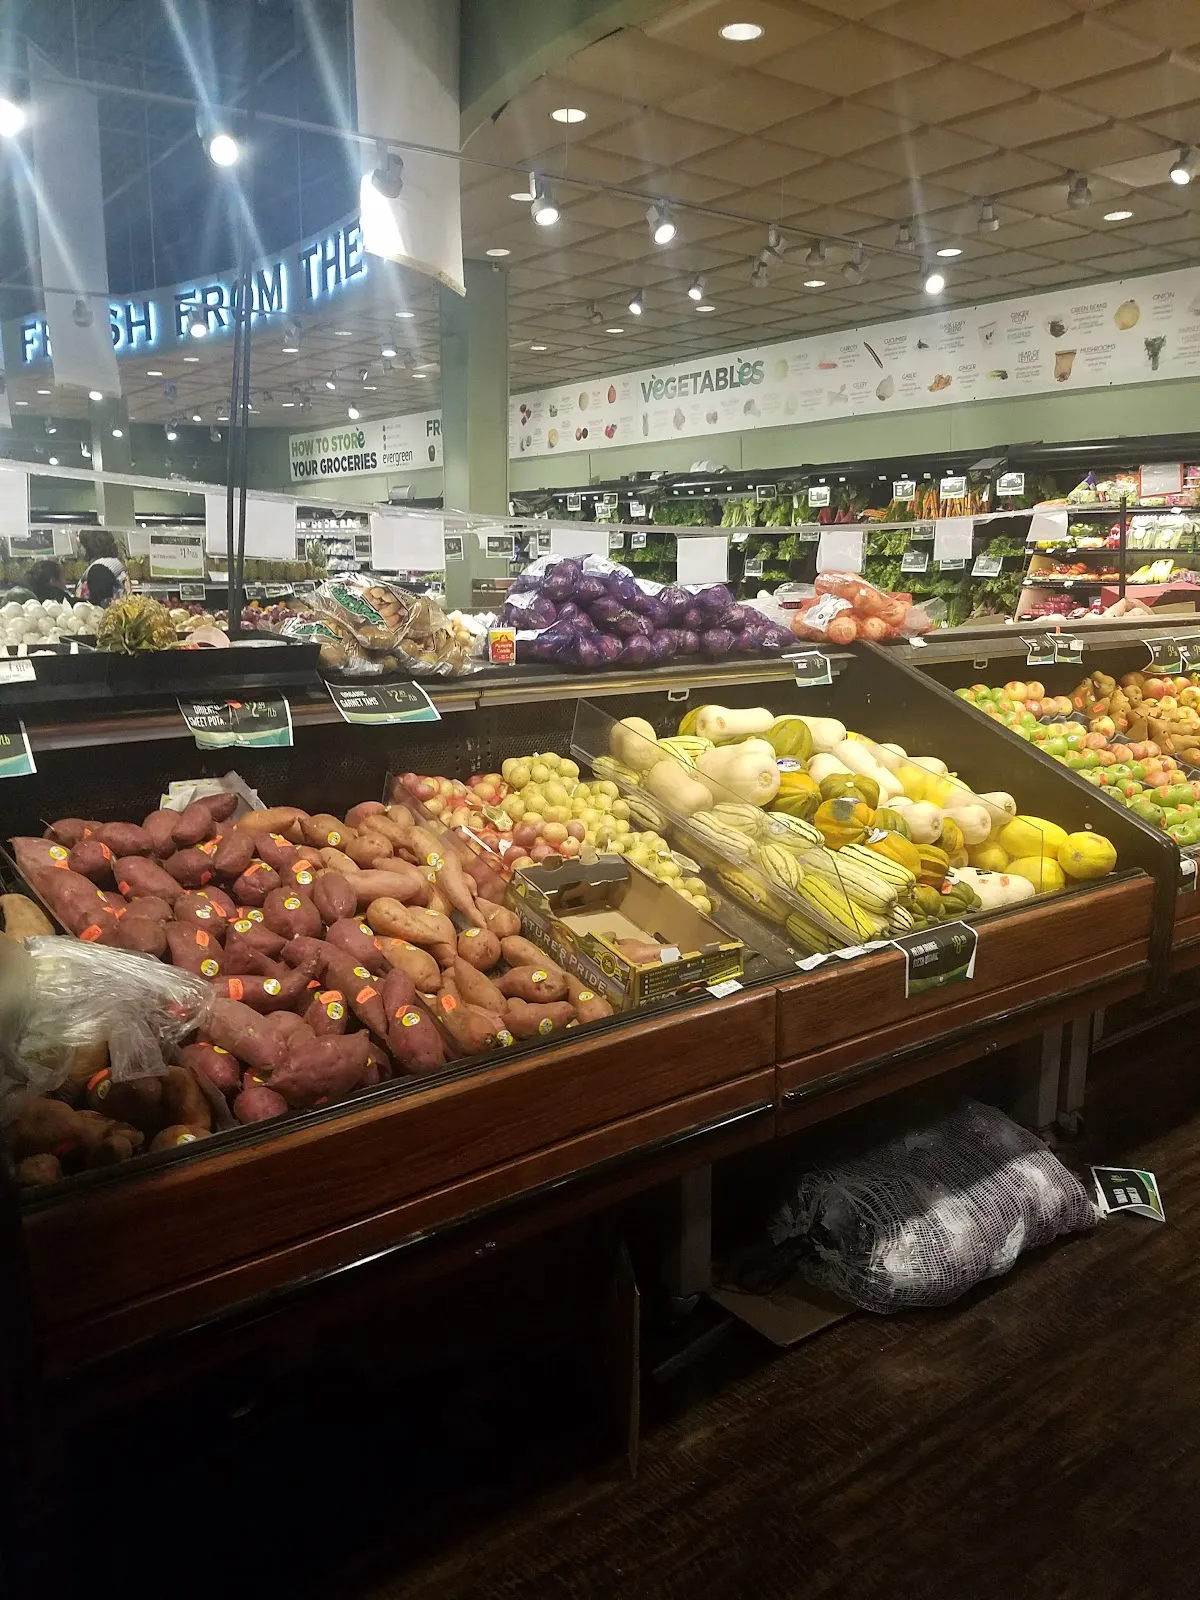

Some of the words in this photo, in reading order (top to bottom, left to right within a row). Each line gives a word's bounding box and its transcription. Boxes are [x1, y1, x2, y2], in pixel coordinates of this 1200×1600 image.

[20, 300, 153, 364] FSH
[174, 262, 284, 338] FROM
[299, 216, 363, 300] THE
[291, 437, 314, 458] HOW
[316, 434, 329, 454] TO
[382, 449, 414, 467] evergreen
[292, 458, 319, 478] YOUR
[319, 452, 378, 475] GROCERIES
[360, 696, 379, 706] YAMS
[187, 716, 209, 728] SWEET
[569, 954, 608, 995] PRIDE
